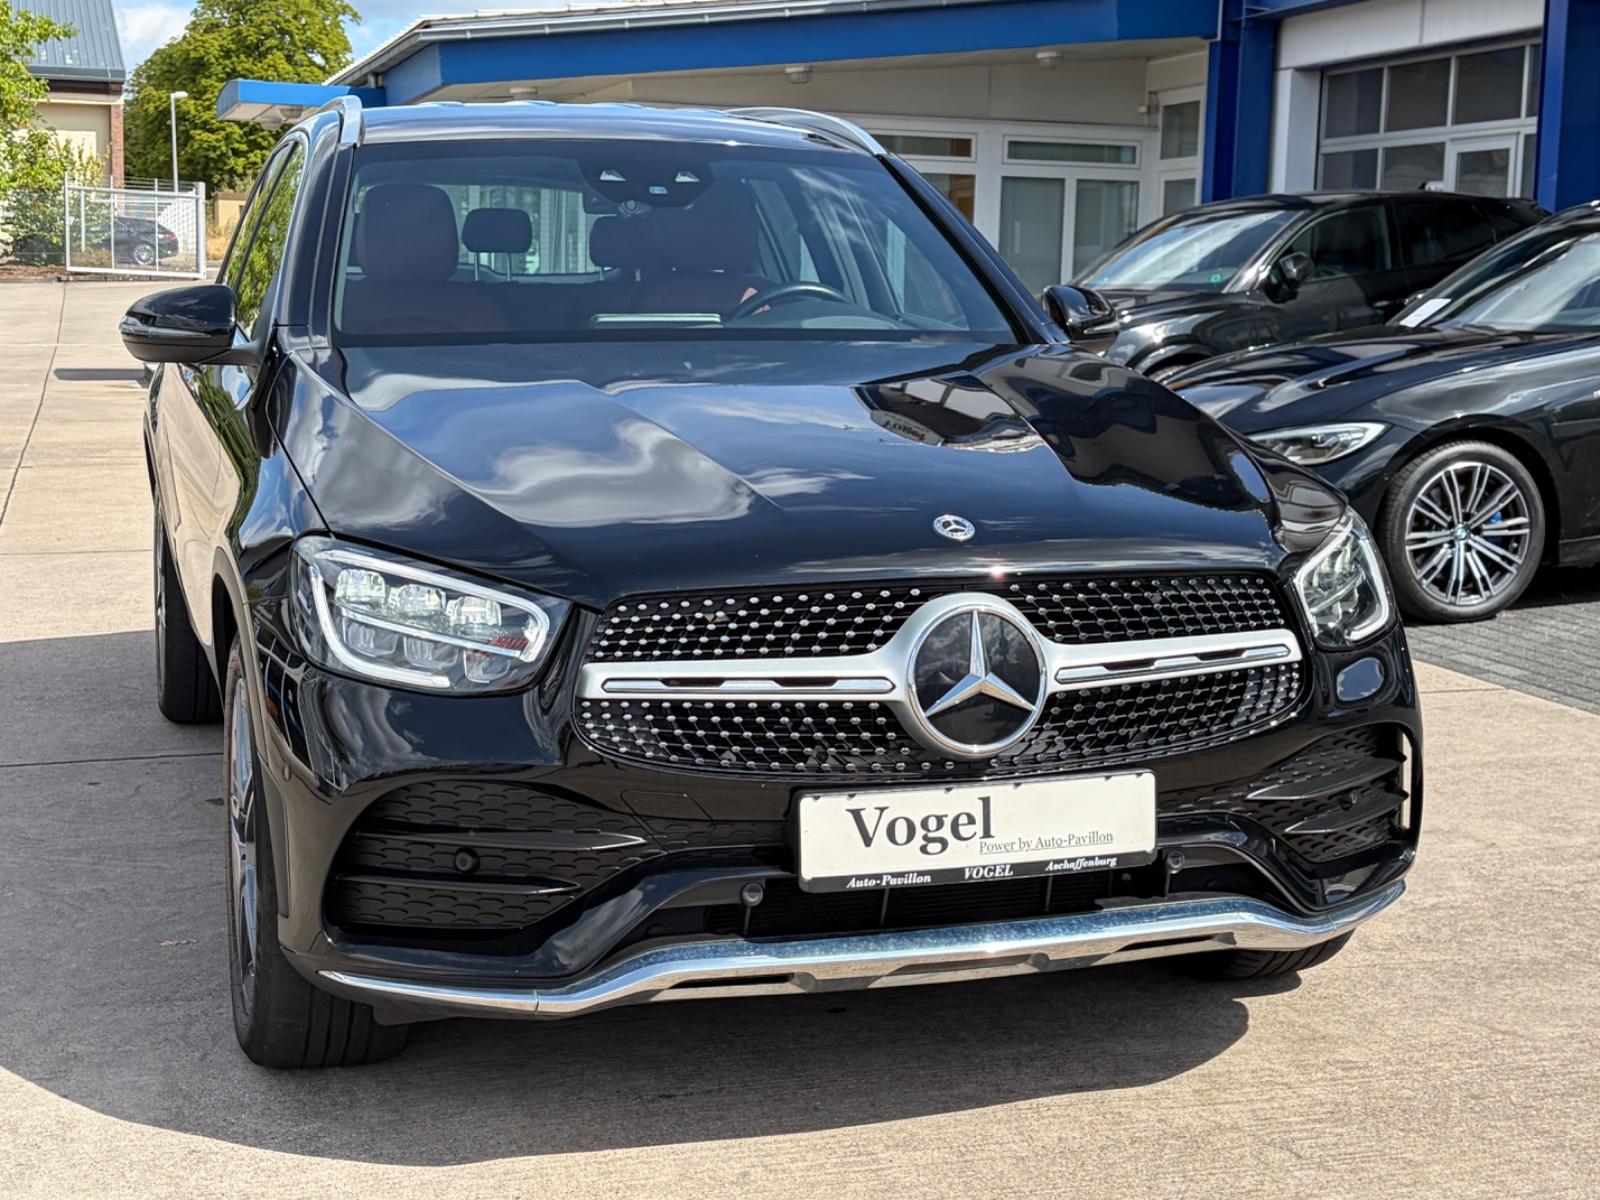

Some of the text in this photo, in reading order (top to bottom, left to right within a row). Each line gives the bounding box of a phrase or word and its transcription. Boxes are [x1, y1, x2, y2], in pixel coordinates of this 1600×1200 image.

[845, 796, 995, 856] Vogel
[979, 830, 1113, 853] Power by Auto-Pavillon
[846, 856, 1118, 889] Auto-Pavillon VOGEL Aschaffenburg
